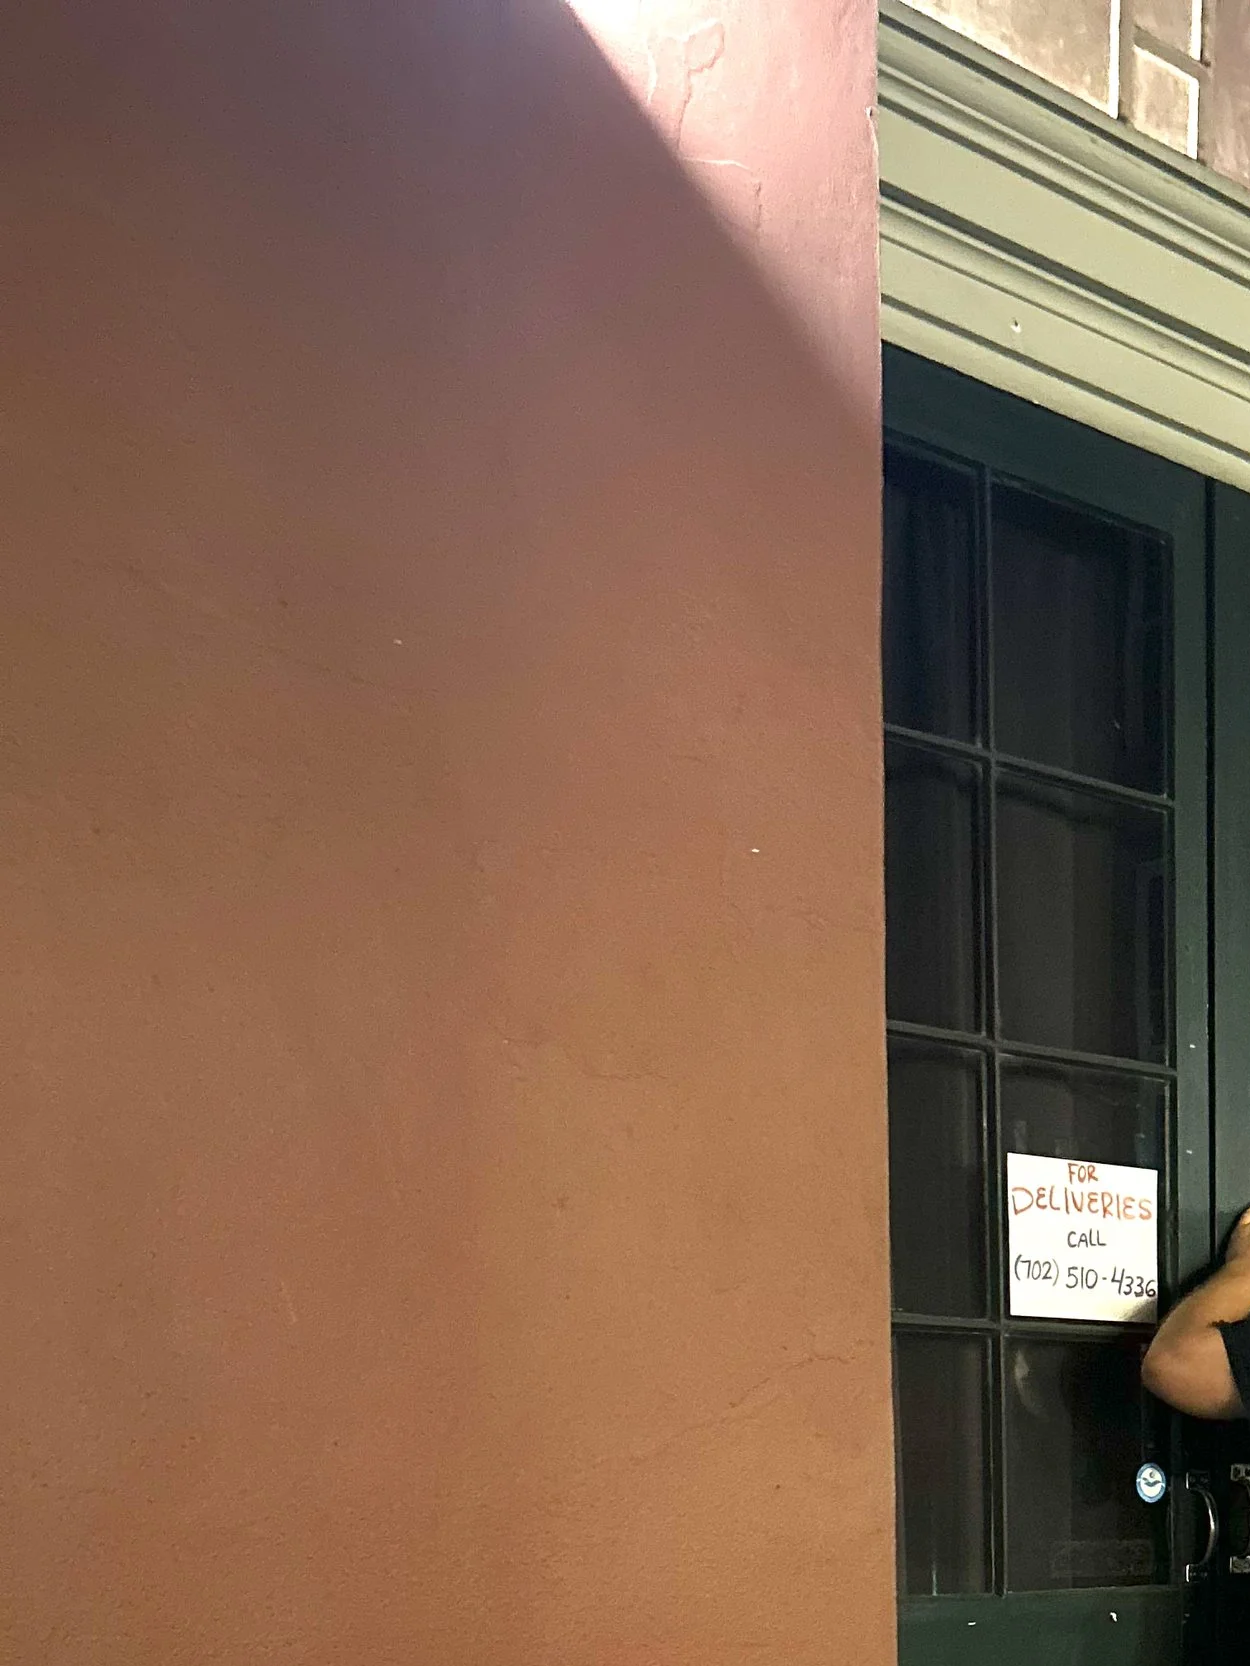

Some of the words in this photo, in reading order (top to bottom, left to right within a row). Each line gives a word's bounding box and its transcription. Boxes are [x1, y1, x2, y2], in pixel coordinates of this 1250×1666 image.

[1067, 1163, 1099, 1184] FOR
[1012, 1186, 1152, 1220] DELIVERIES
[1067, 1228, 1107, 1248] CALL
[1014, 1254, 1060, 1287] (702)
